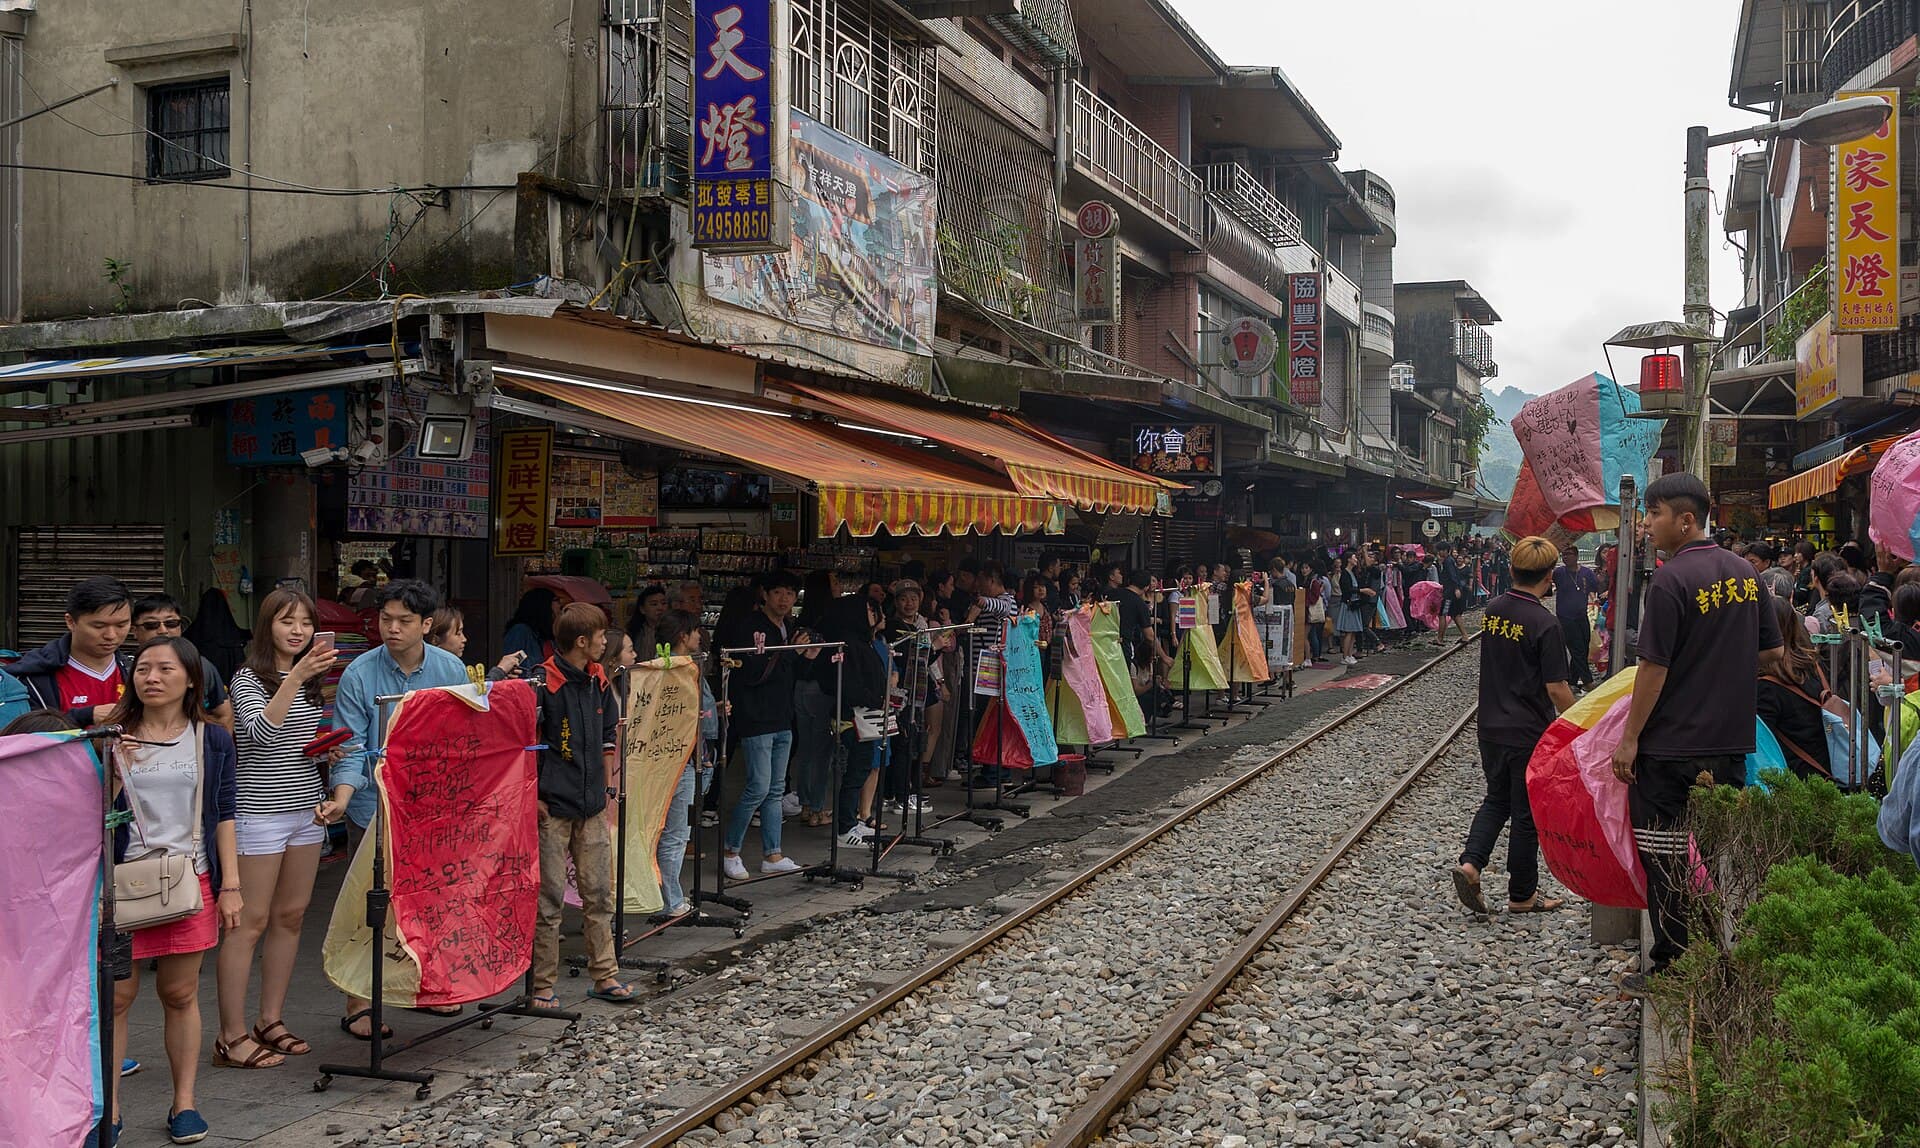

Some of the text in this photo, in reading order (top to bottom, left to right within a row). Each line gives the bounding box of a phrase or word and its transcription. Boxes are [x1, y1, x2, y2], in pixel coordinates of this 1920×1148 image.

[701, 6, 766, 171] 天燈
[697, 178, 768, 207] 批發零售
[1844, 97, 1890, 297] 家天燈
[697, 210, 768, 241] 24958850
[1291, 276, 1317, 379] 協豐天燈
[1841, 315, 1894, 328] 2495-8131
[1136, 427, 1212, 456] 你會紅
[506, 435, 542, 549] 吉祥天燈
[1695, 577, 1759, 615] 吉祥天燈
[130, 762, 165, 777] weet
